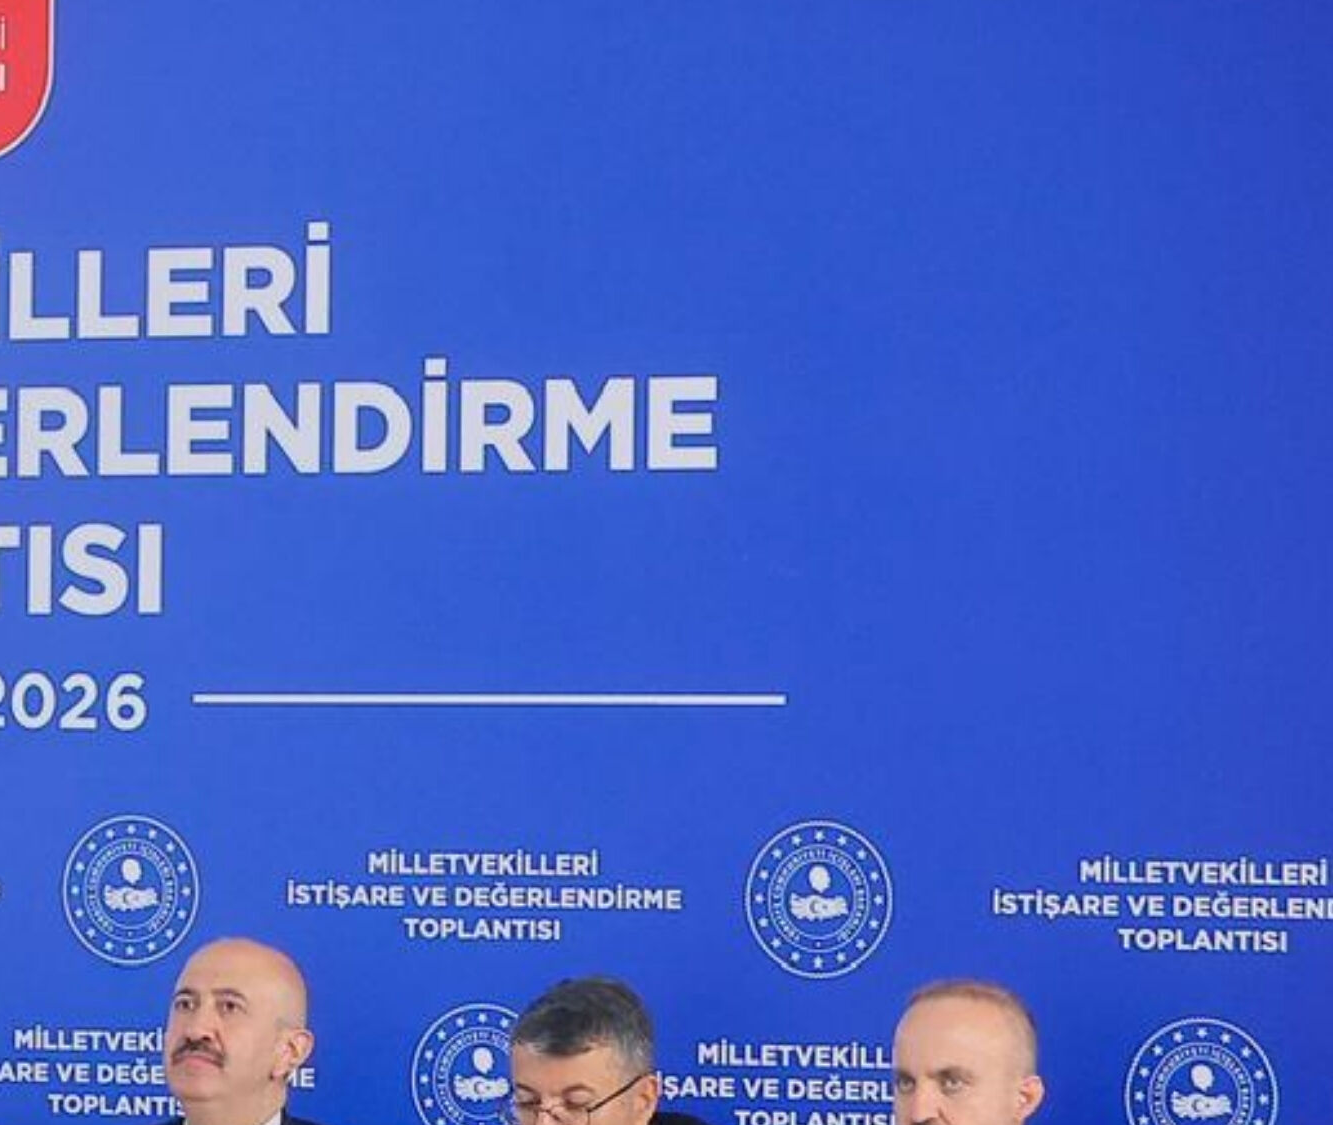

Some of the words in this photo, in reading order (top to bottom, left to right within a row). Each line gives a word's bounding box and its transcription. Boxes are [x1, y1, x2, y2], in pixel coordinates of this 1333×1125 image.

[368, 848, 598, 876] MİLLETVEKİLLERİ
[1080, 856, 1327, 886] MİLLETVEKİLLERİ
[287, 879, 405, 909] İSTİŞARE
[412, 886, 447, 907] VE
[455, 882, 682, 910] DEĞERLENDİRME
[993, 889, 1119, 919] İSTİŞARE
[1127, 895, 1165, 917] VE
[404, 918, 561, 940] TOPLANTISI
[1118, 928, 1287, 952] TOPLANTISI
[13, 1026, 163, 1052] MİLLETVEKİ
[697, 1038, 891, 1070] MİLLETVEKİLL
[55, 1063, 90, 1083] VE
[743, 1077, 779, 1099] VE
